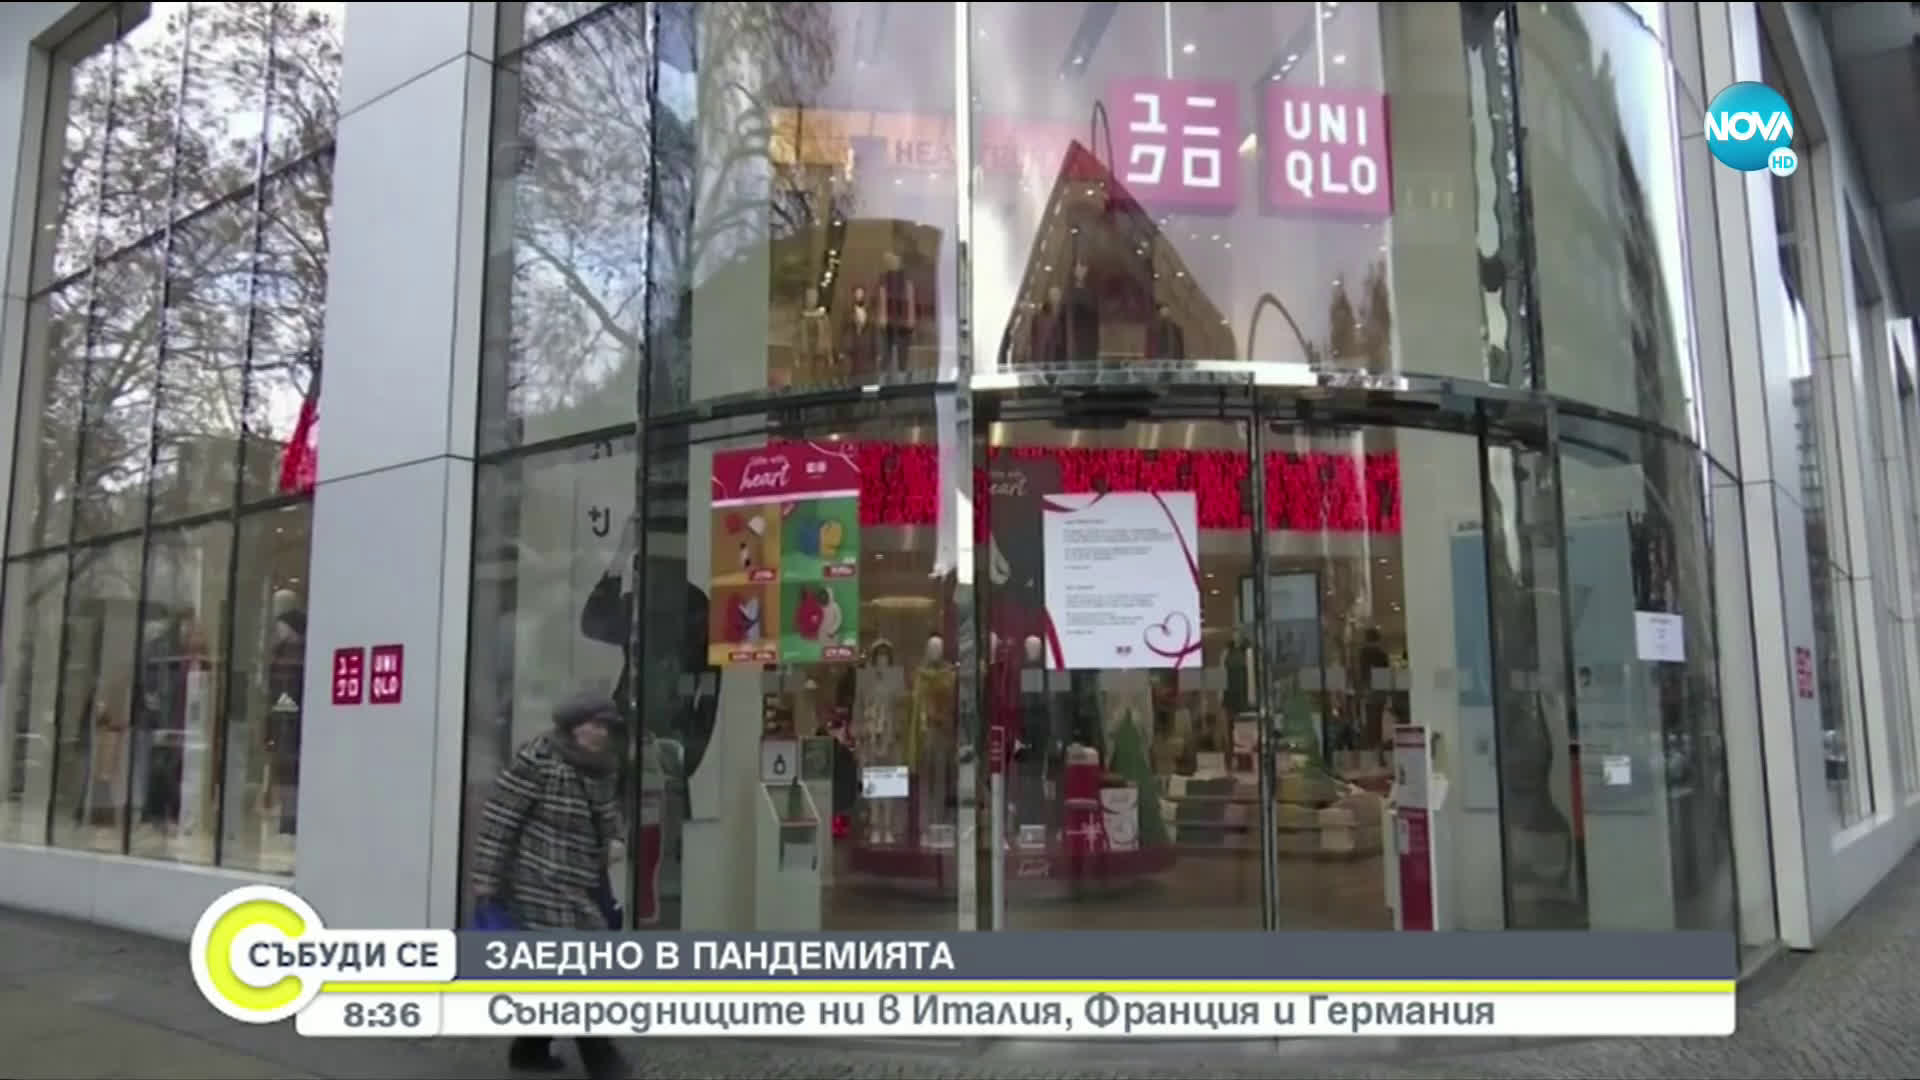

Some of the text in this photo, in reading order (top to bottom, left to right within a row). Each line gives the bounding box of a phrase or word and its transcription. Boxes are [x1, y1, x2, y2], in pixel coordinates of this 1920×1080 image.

[1284, 100, 1367, 144] UNI
[1286, 151, 1377, 198] QLO
[739, 461, 790, 491] heart
[374, 654, 397, 672] UNI
[373, 675, 398, 697] QLO
